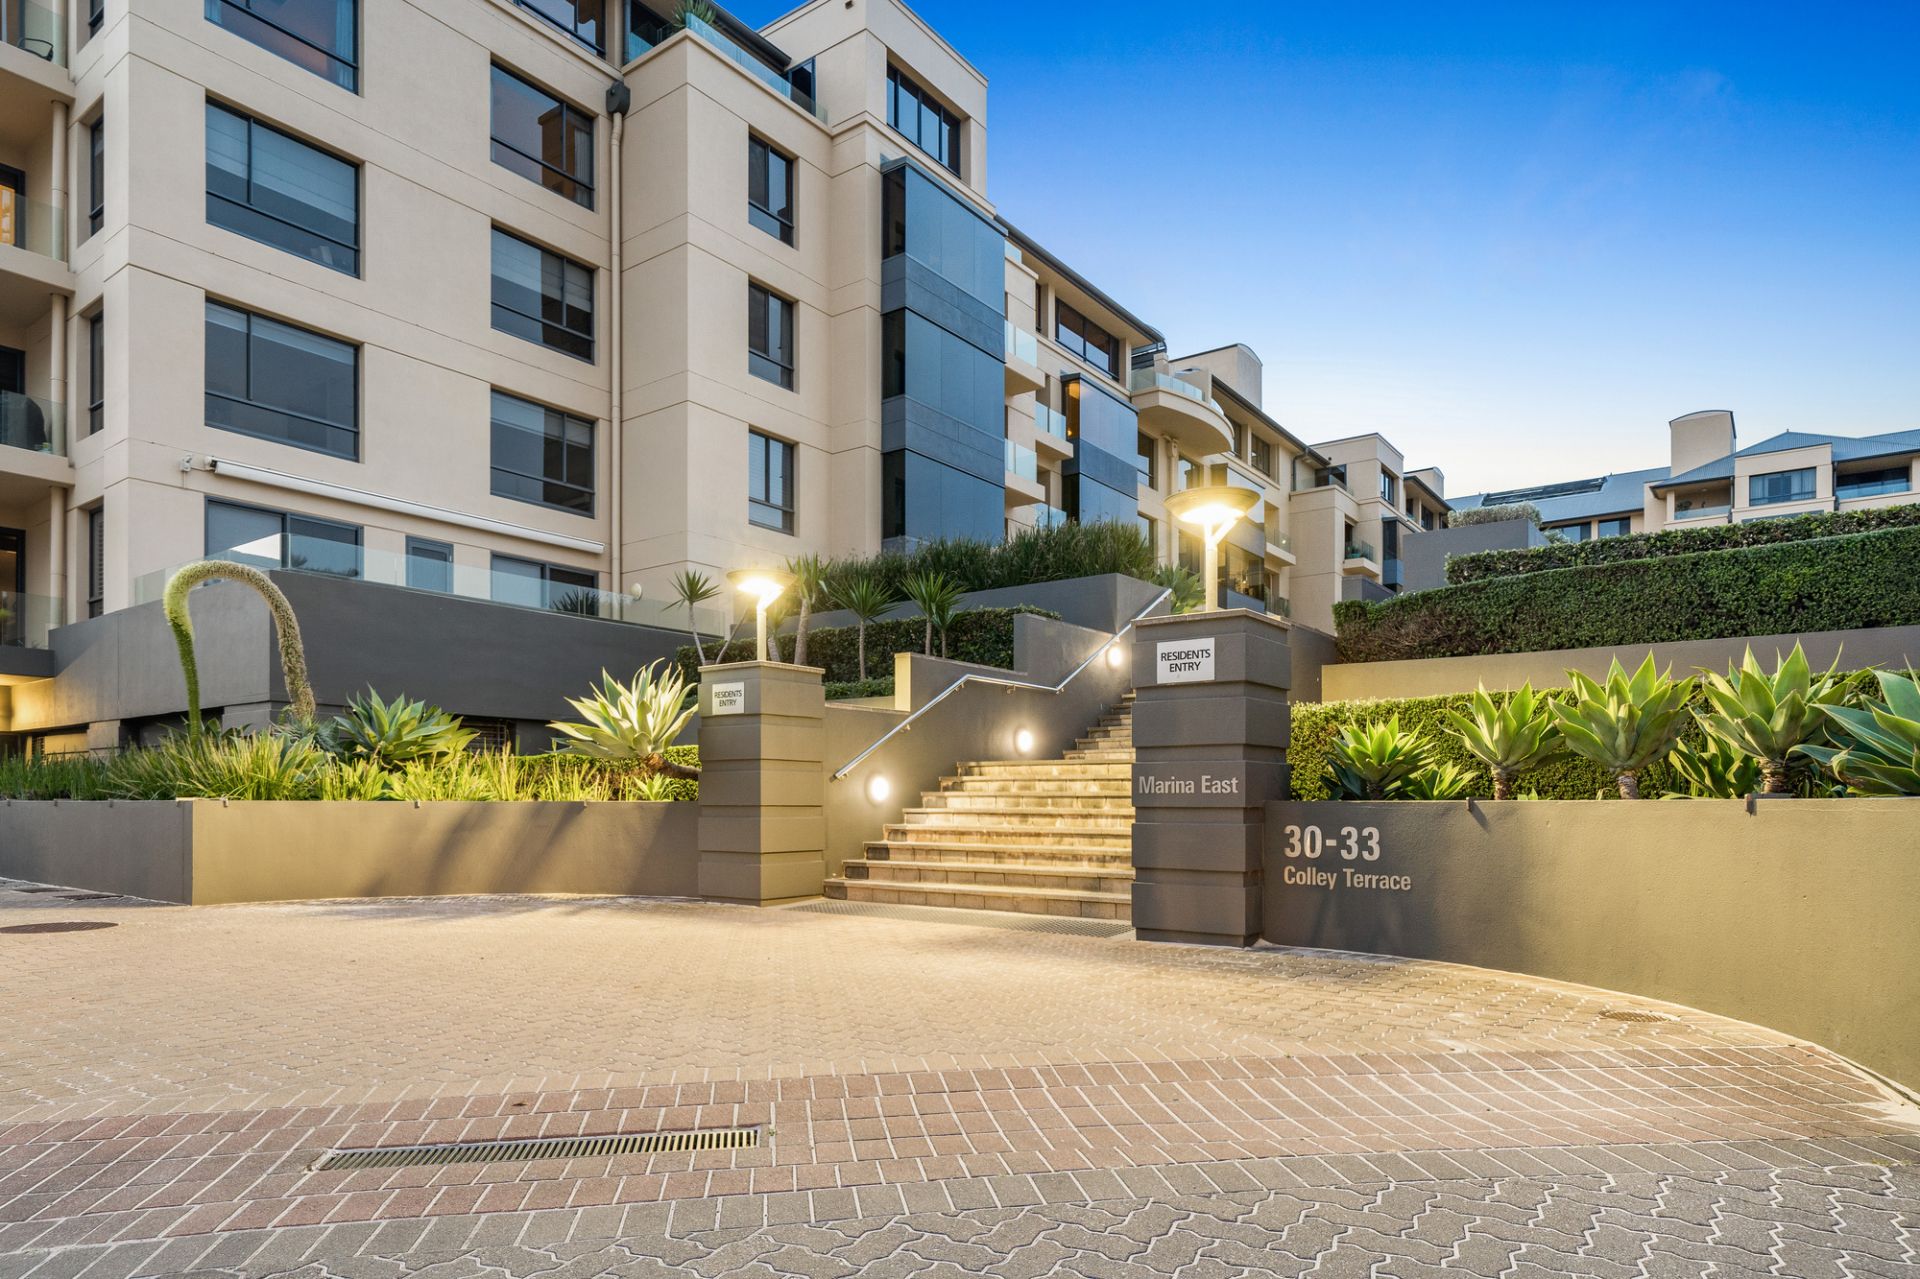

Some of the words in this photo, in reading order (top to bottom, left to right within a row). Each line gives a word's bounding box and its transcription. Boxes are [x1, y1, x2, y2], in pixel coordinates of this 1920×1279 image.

[1160, 649, 1211, 661] RESIDENTS
[1169, 661, 1201, 673] ENTRY
[714, 690, 743, 698] RESIDENTS
[719, 699, 737, 707] ENTRY
[1139, 776, 1195, 794] Marina
[1201, 775, 1239, 794] East
[1284, 825, 1381, 861] 30-33
[1283, 865, 1337, 890] Colley
[1342, 868, 1412, 891] Terrace
